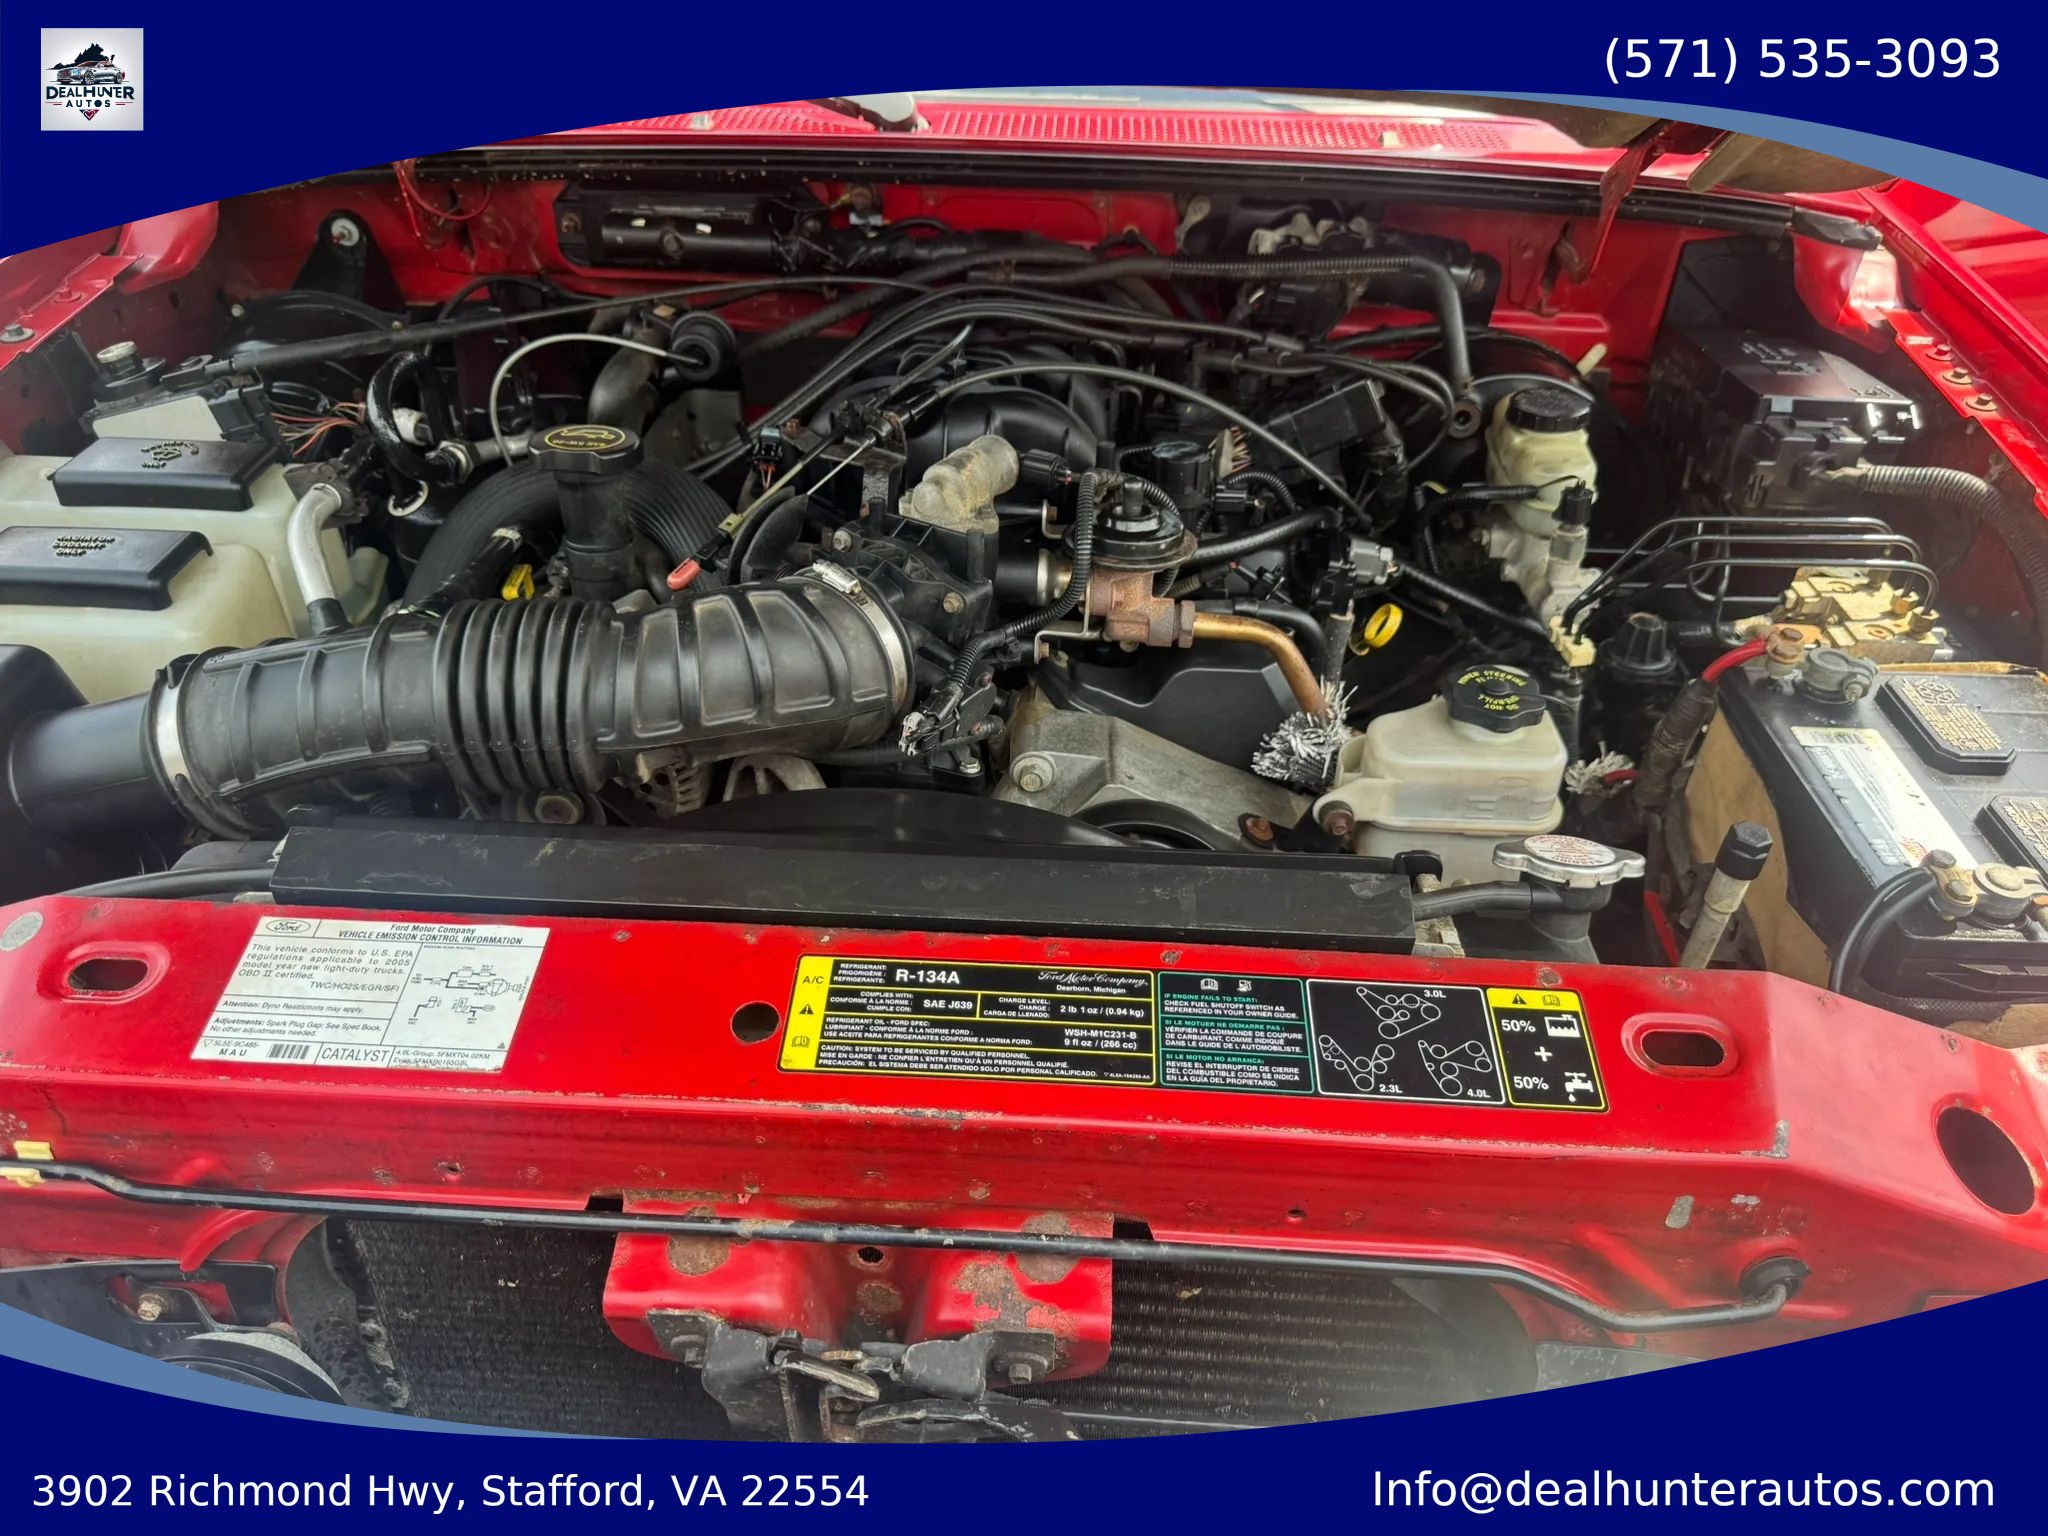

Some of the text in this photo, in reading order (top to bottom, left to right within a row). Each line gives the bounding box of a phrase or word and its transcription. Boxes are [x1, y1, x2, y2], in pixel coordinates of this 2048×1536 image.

[273, 920, 302, 931] Ford
[390, 924, 408, 932] Ford
[438, 926, 476, 934] Company
[339, 930, 523, 944] VEHICLE EMISSION CONTROL INFORMATION
[275, 945, 307, 953] vehicle
[311, 946, 354, 955] conforms
[371, 948, 391, 956] U.S.
[394, 949, 414, 957] EPA
[247, 953, 305, 963] regulations
[310, 955, 362, 964] applicable
[385, 958, 410, 966] 2005
[242, 961, 272, 970] model
[275, 962, 296, 971] year
[300, 964, 319, 972] new
[324, 964, 369, 973] light-duty
[802, 976, 824, 984] A/C
[896, 969, 960, 984] R-134A
[1038, 971, 1148, 988] Ford Motor Company
[1093, 986, 1126, 994] Michigan
[1424, 989, 1446, 998] 3.0L
[222, 1000, 260, 1009] Attention:
[262, 1002, 280, 1010] Dyno
[282, 1003, 324, 1012] Restrictions
[923, 1000, 973, 1009] SAE J639
[1210, 1002, 1243, 1010] SHUTOFF
[1068, 1006, 1076, 1014] lb
[1081, 1006, 1084, 1014] 1
[1087, 1006, 1098, 1015] oz
[1105, 1007, 1126, 1016] (0.94
[1129, 1008, 1144, 1017] kg)
[1165, 1007, 1212, 1015] REFERENCED
[1245, 1010, 1272, 1018] OWNER
[214, 1018, 264, 1027] Adjustments:
[266, 1020, 287, 1028] Spark
[826, 1017, 872, 1025] REFRIGERANT
[1501, 1019, 1536, 1032] 50%
[242, 1027, 286, 1035] adjustments
[825, 1024, 863, 1032] LUBRIFIANT
[1065, 1029, 1137, 1039] WSH-M1C231-B
[1072, 1039, 1078, 1047] fl
[1081, 1039, 1092, 1048] oz
[1123, 1040, 1137, 1050] cc)
[321, 1048, 389, 1062] CATALYST
[1380, 1084, 1403, 1093] 2.3L
[1513, 1077, 1549, 1090] 50%
[1467, 1089, 1490, 1098] 4.0L
